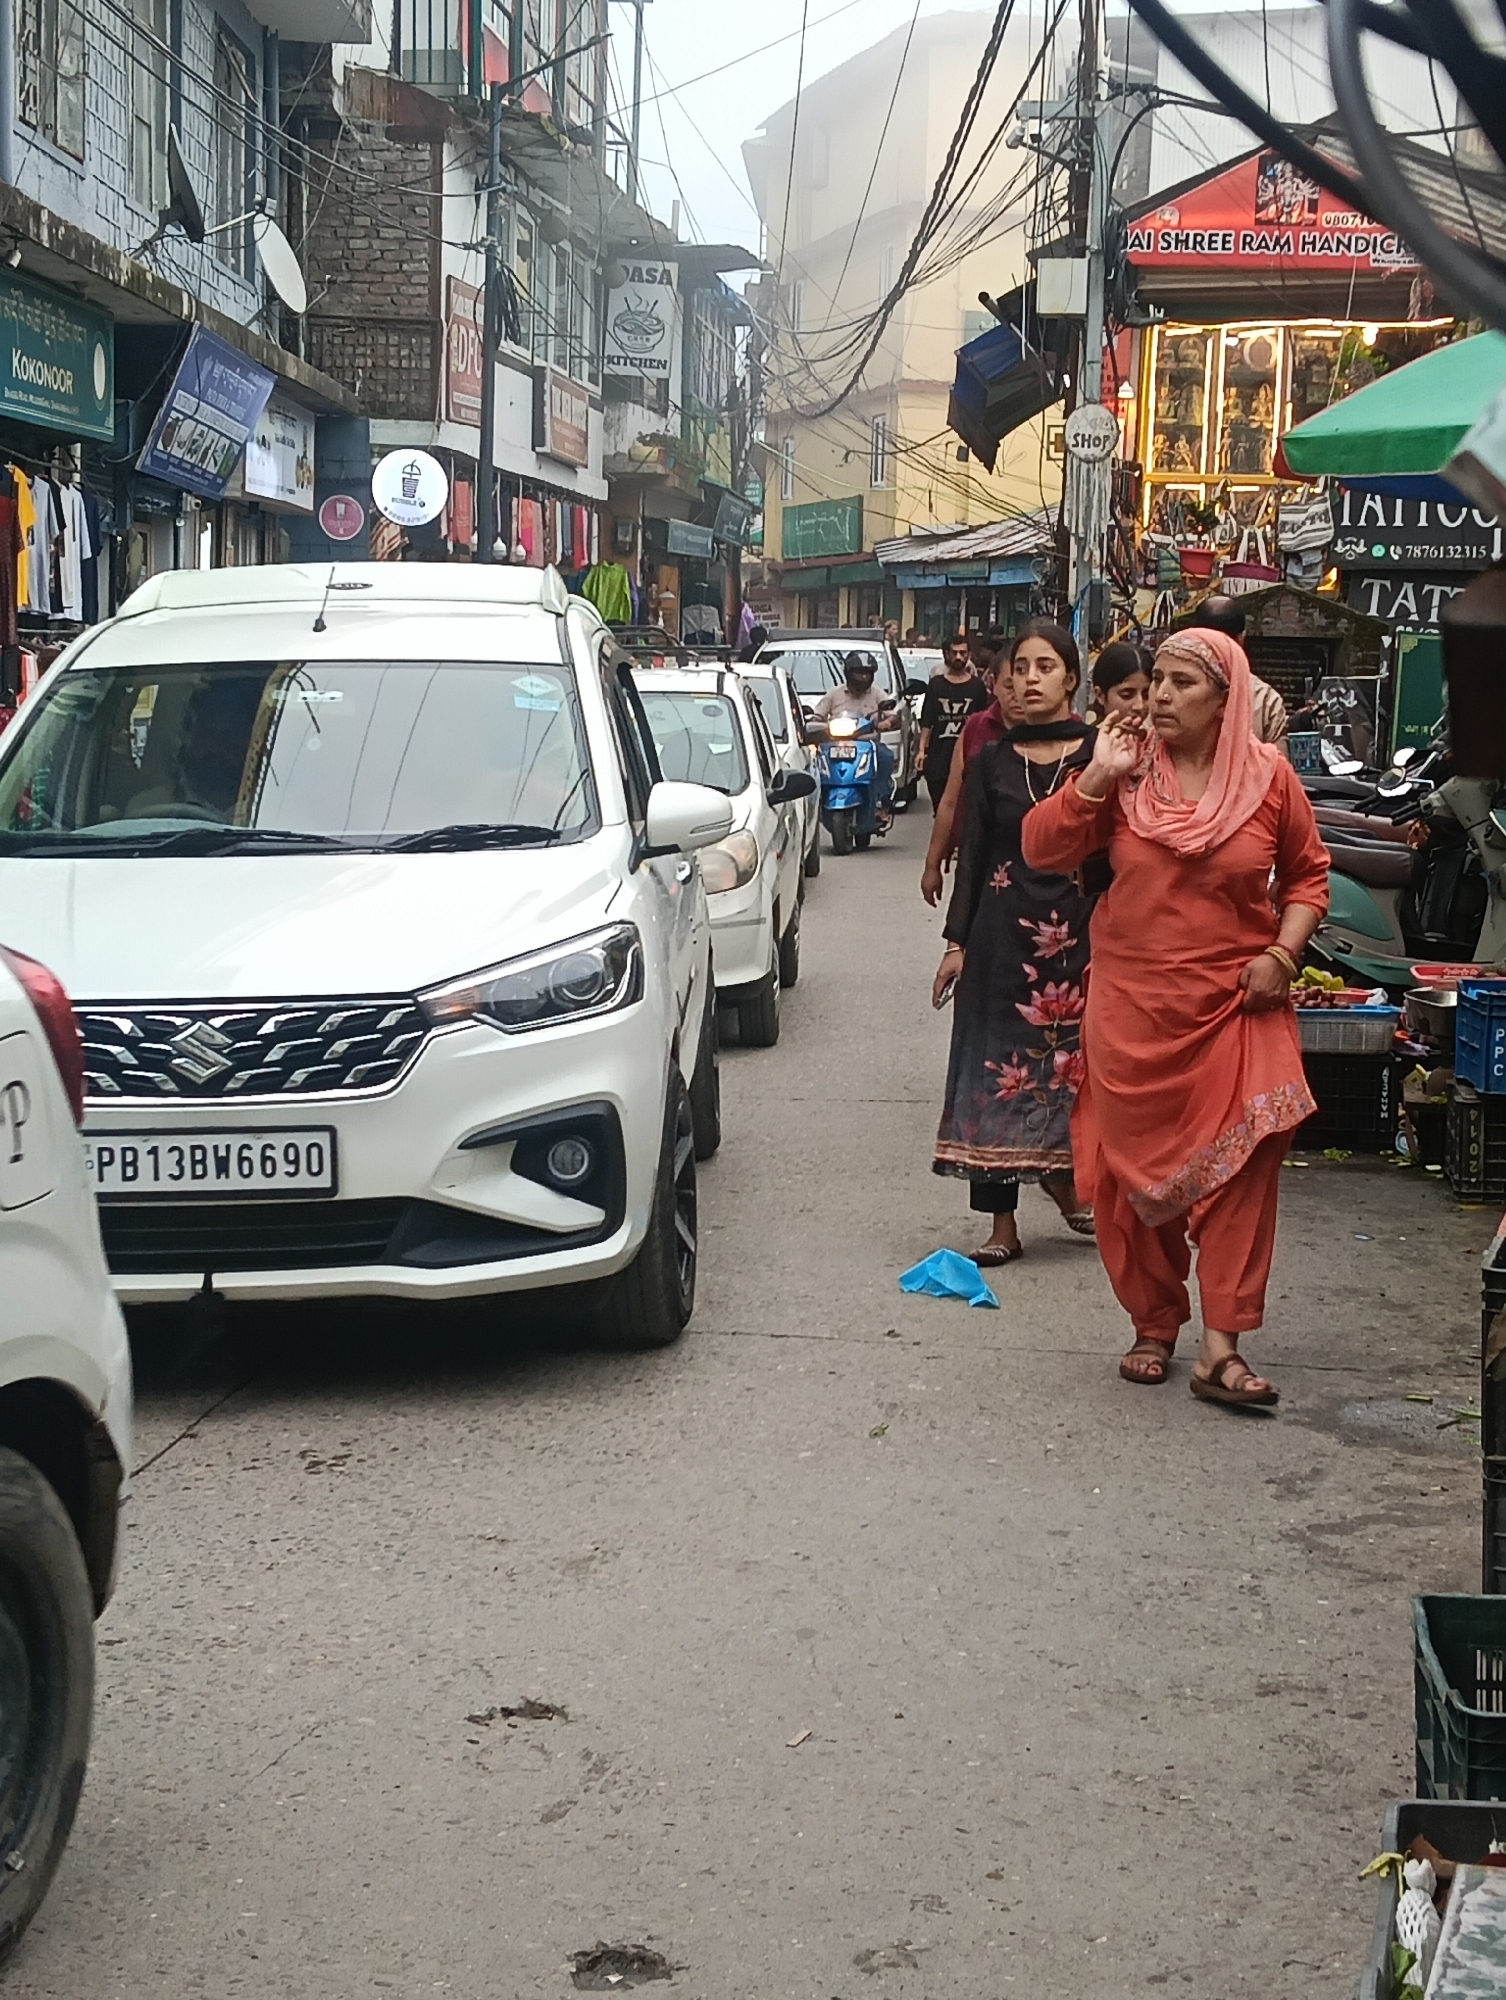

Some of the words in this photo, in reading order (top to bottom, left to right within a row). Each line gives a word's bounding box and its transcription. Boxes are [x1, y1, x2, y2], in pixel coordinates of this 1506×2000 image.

[1160, 231, 1233, 251] SHREE
[1241, 232, 1291, 252] RAM
[606, 354, 668, 370] KITCHEN
[1072, 432, 1111, 451] SHOP
[1405, 545, 1487, 559] 7876132315
[97, 1142, 325, 1183] PB13BW6690
